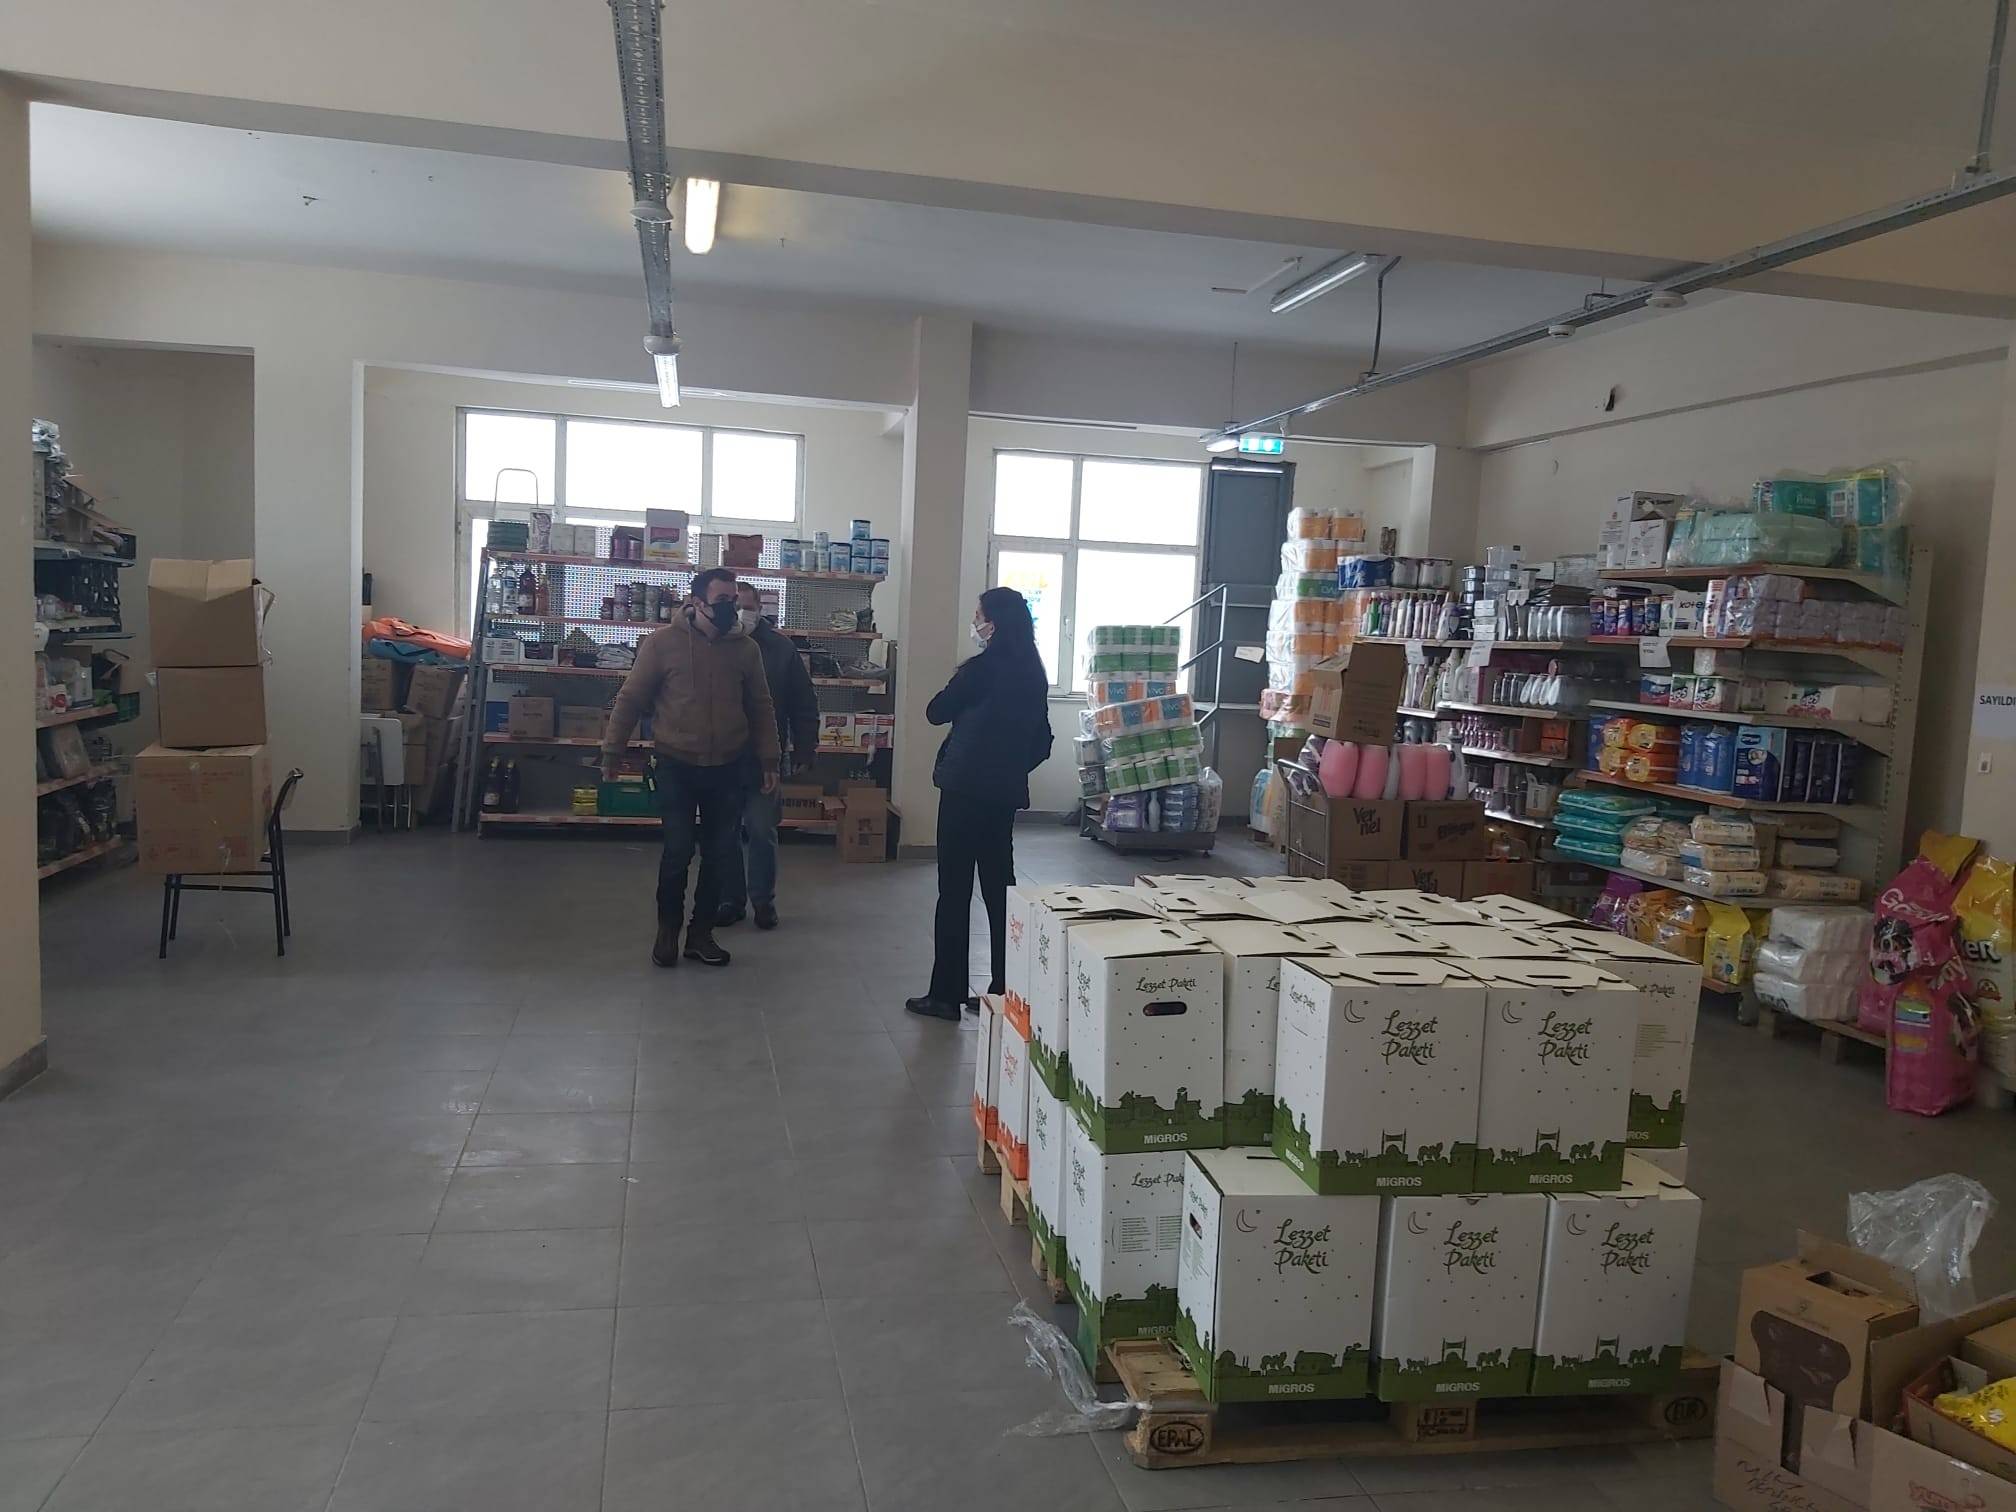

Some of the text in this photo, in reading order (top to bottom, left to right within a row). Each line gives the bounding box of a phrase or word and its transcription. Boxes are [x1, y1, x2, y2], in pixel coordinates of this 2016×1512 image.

[1381, 1009, 1438, 1041] Lezzet
[1537, 1010, 1593, 1042] Lezzet
[1381, 1039, 1437, 1066] Paketi
[1537, 1040, 1589, 1066] Paketi
[1273, 1218, 1332, 1250] Lezzet
[1443, 1220, 1499, 1251] Lezzet
[1600, 1222, 1655, 1252] Lezzet
[1273, 1247, 1329, 1275] Paketi
[1442, 1248, 1497, 1275] Paketi
[1599, 1249, 1652, 1275] Paketi
